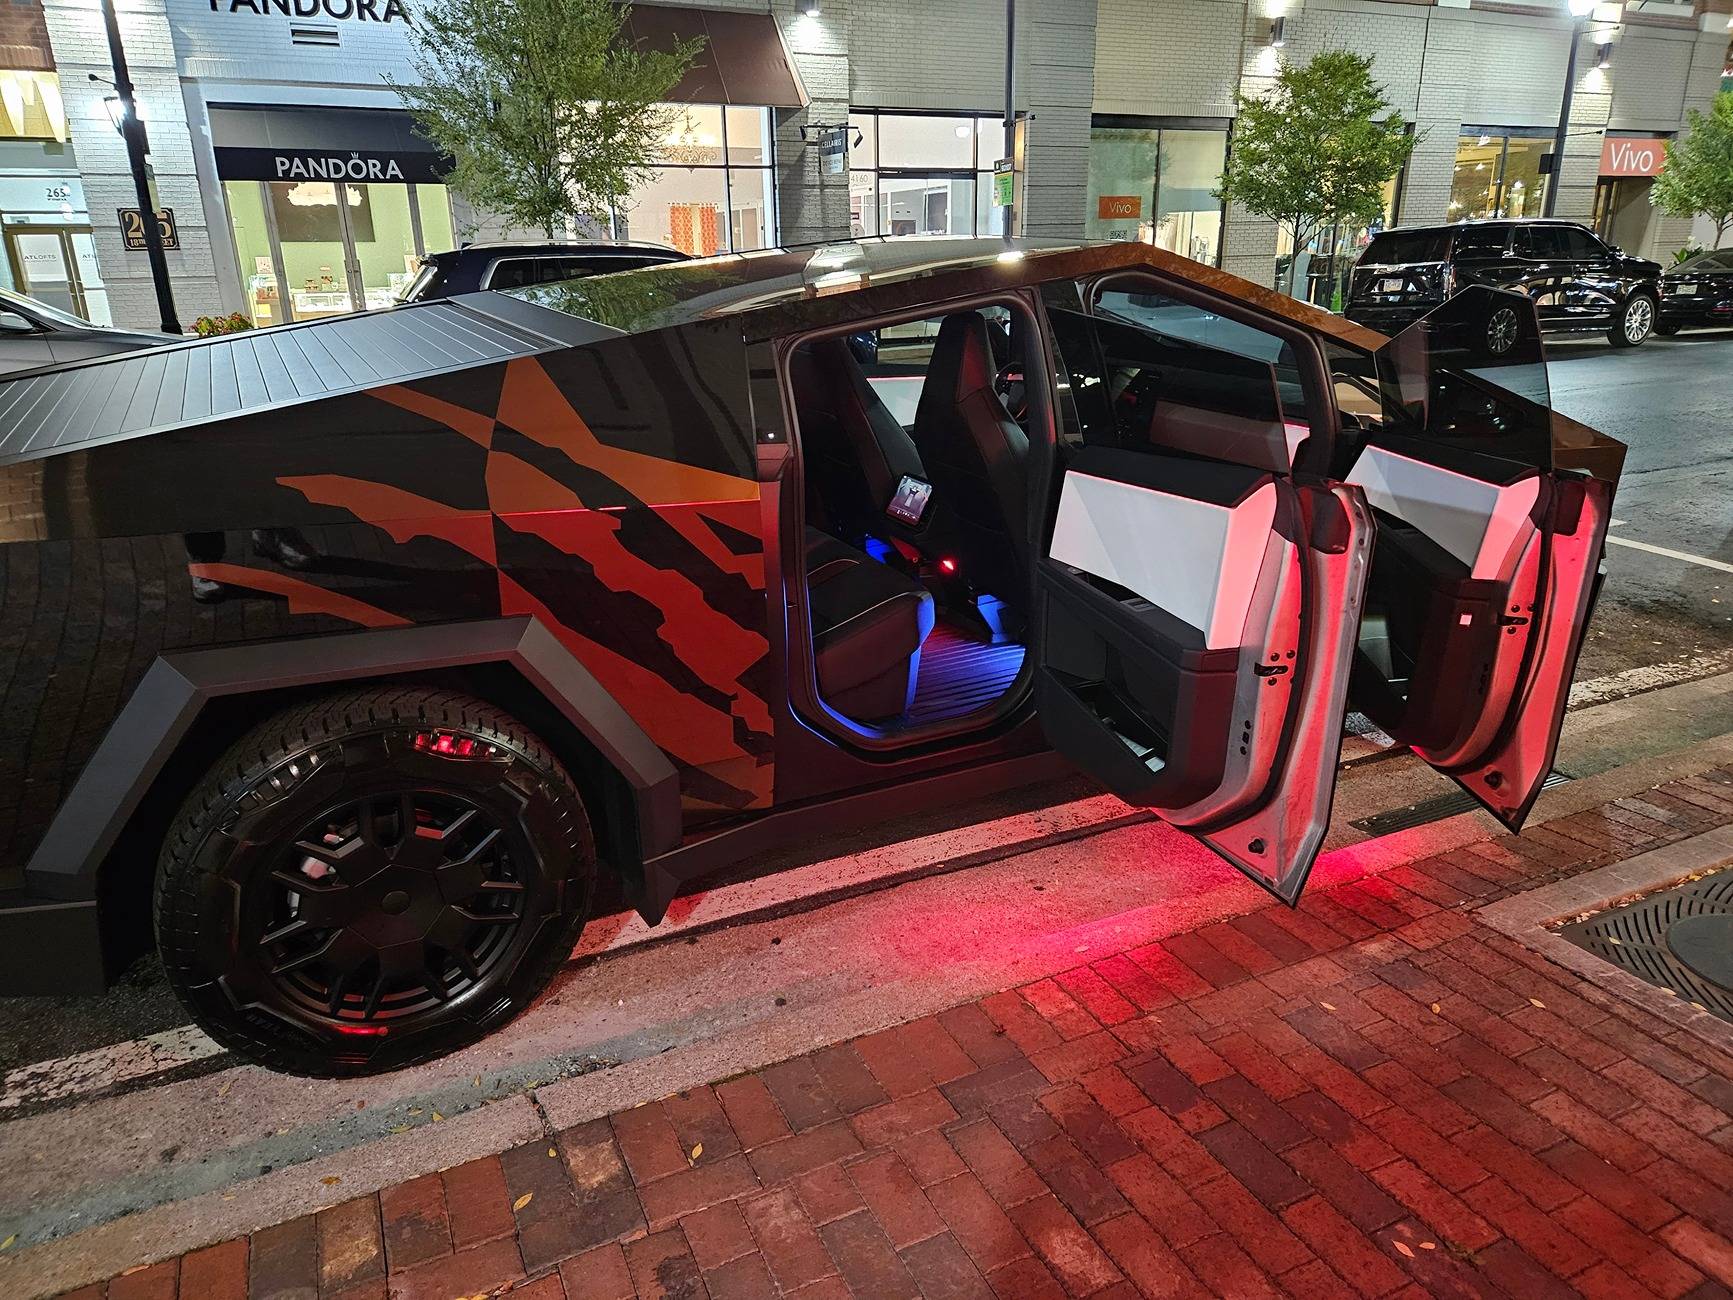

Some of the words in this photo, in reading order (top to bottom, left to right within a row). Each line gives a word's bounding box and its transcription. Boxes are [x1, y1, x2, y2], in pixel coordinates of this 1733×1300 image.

[1611, 142, 1654, 172] Vivo
[275, 156, 404, 179] PANDORA
[45, 187, 67, 197] 265
[1109, 201, 1132, 214] Vivo
